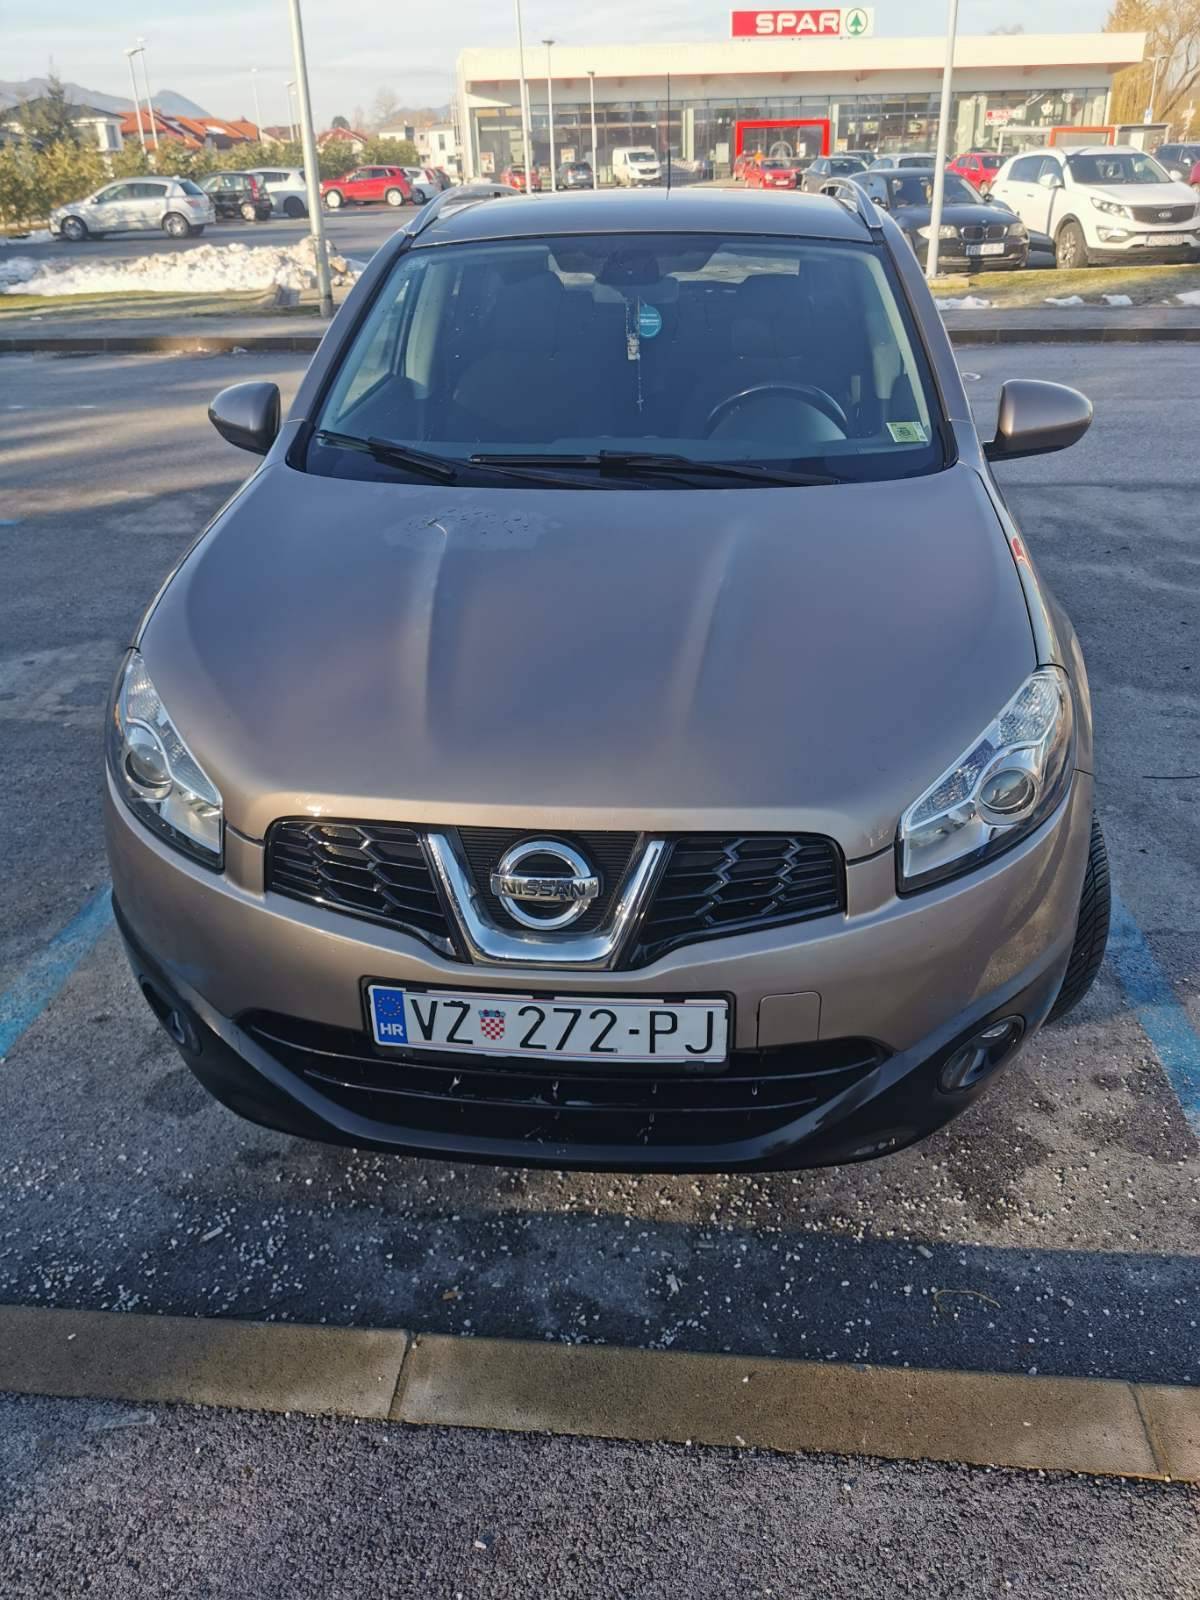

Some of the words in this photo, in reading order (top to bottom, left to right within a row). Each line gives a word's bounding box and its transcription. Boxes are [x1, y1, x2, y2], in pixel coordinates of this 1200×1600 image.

[756, 13, 839, 34] SPAR
[501, 879, 585, 897] NISSAN
[380, 1022, 404, 1037] HR
